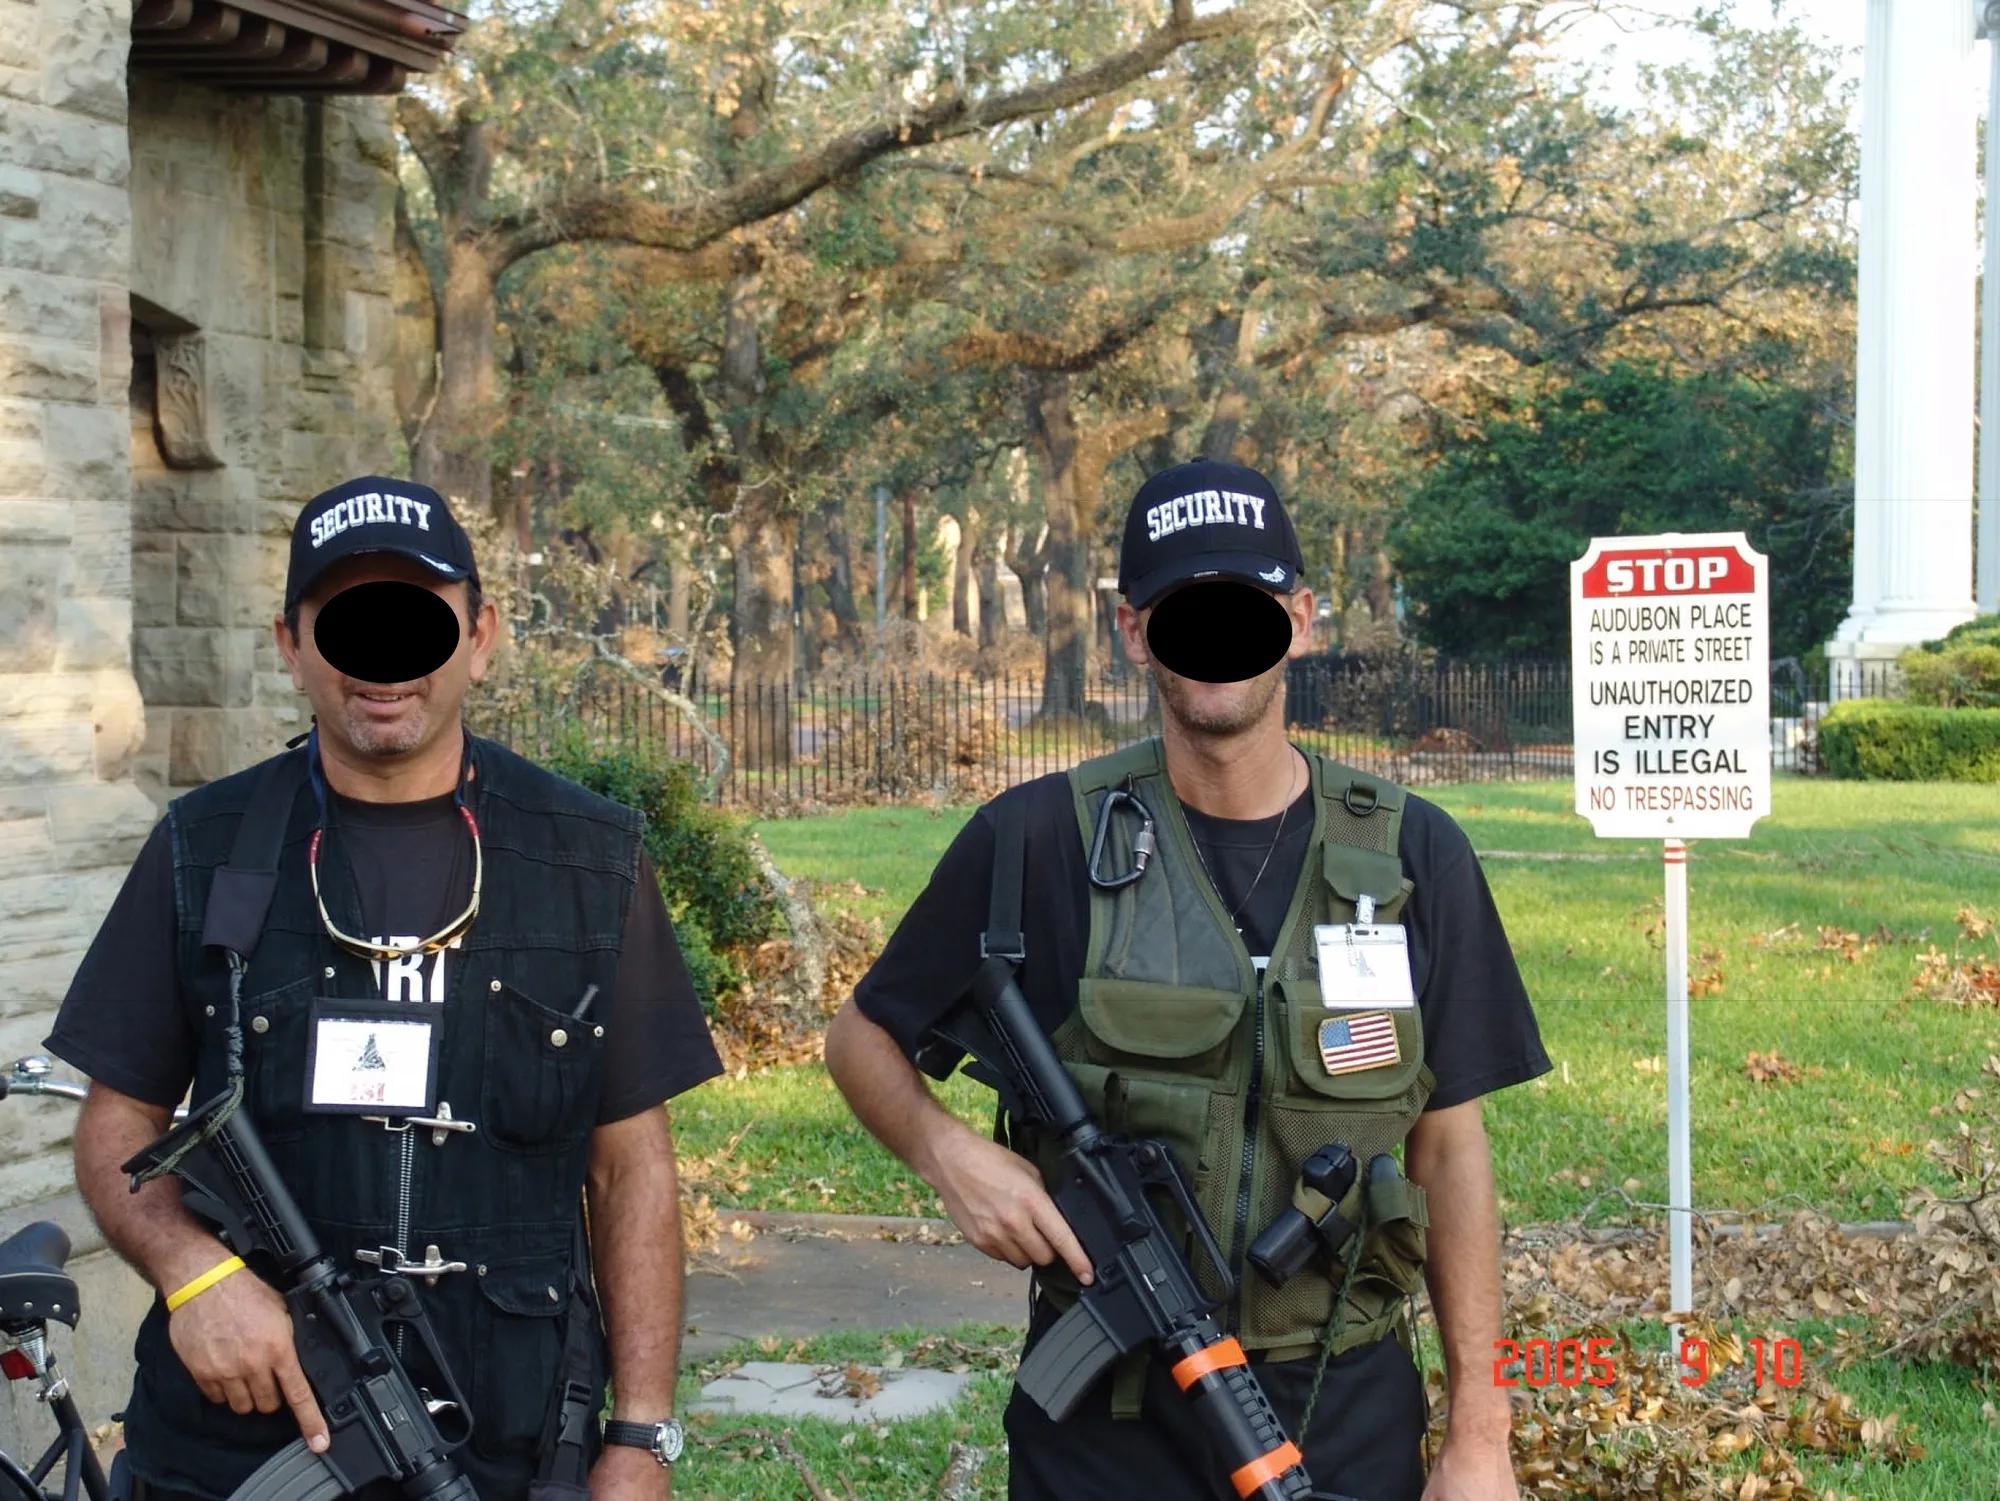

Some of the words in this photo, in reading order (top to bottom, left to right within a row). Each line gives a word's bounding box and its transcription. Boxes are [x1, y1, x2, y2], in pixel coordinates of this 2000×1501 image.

[310, 492, 432, 549] SECURITY
[1146, 490, 1266, 542] SECURITY
[1606, 555, 1729, 594] STOP
[1590, 606, 1681, 633] AUDUBON
[1690, 603, 1753, 629] PLACE
[1590, 641, 1603, 665] IS
[1611, 640, 1622, 664] A
[1628, 638, 1686, 664] PRIVATE
[1694, 636, 1753, 662] STREET
[1590, 679, 1753, 706] UNAUTHORIZED
[1624, 714, 1715, 740] ENTRY
[1594, 750, 1620, 775] IS
[1635, 749, 1748, 775] ILLEGAL
[1590, 786, 1616, 811] NO
[1625, 786, 1753, 811] TRESPASSING
